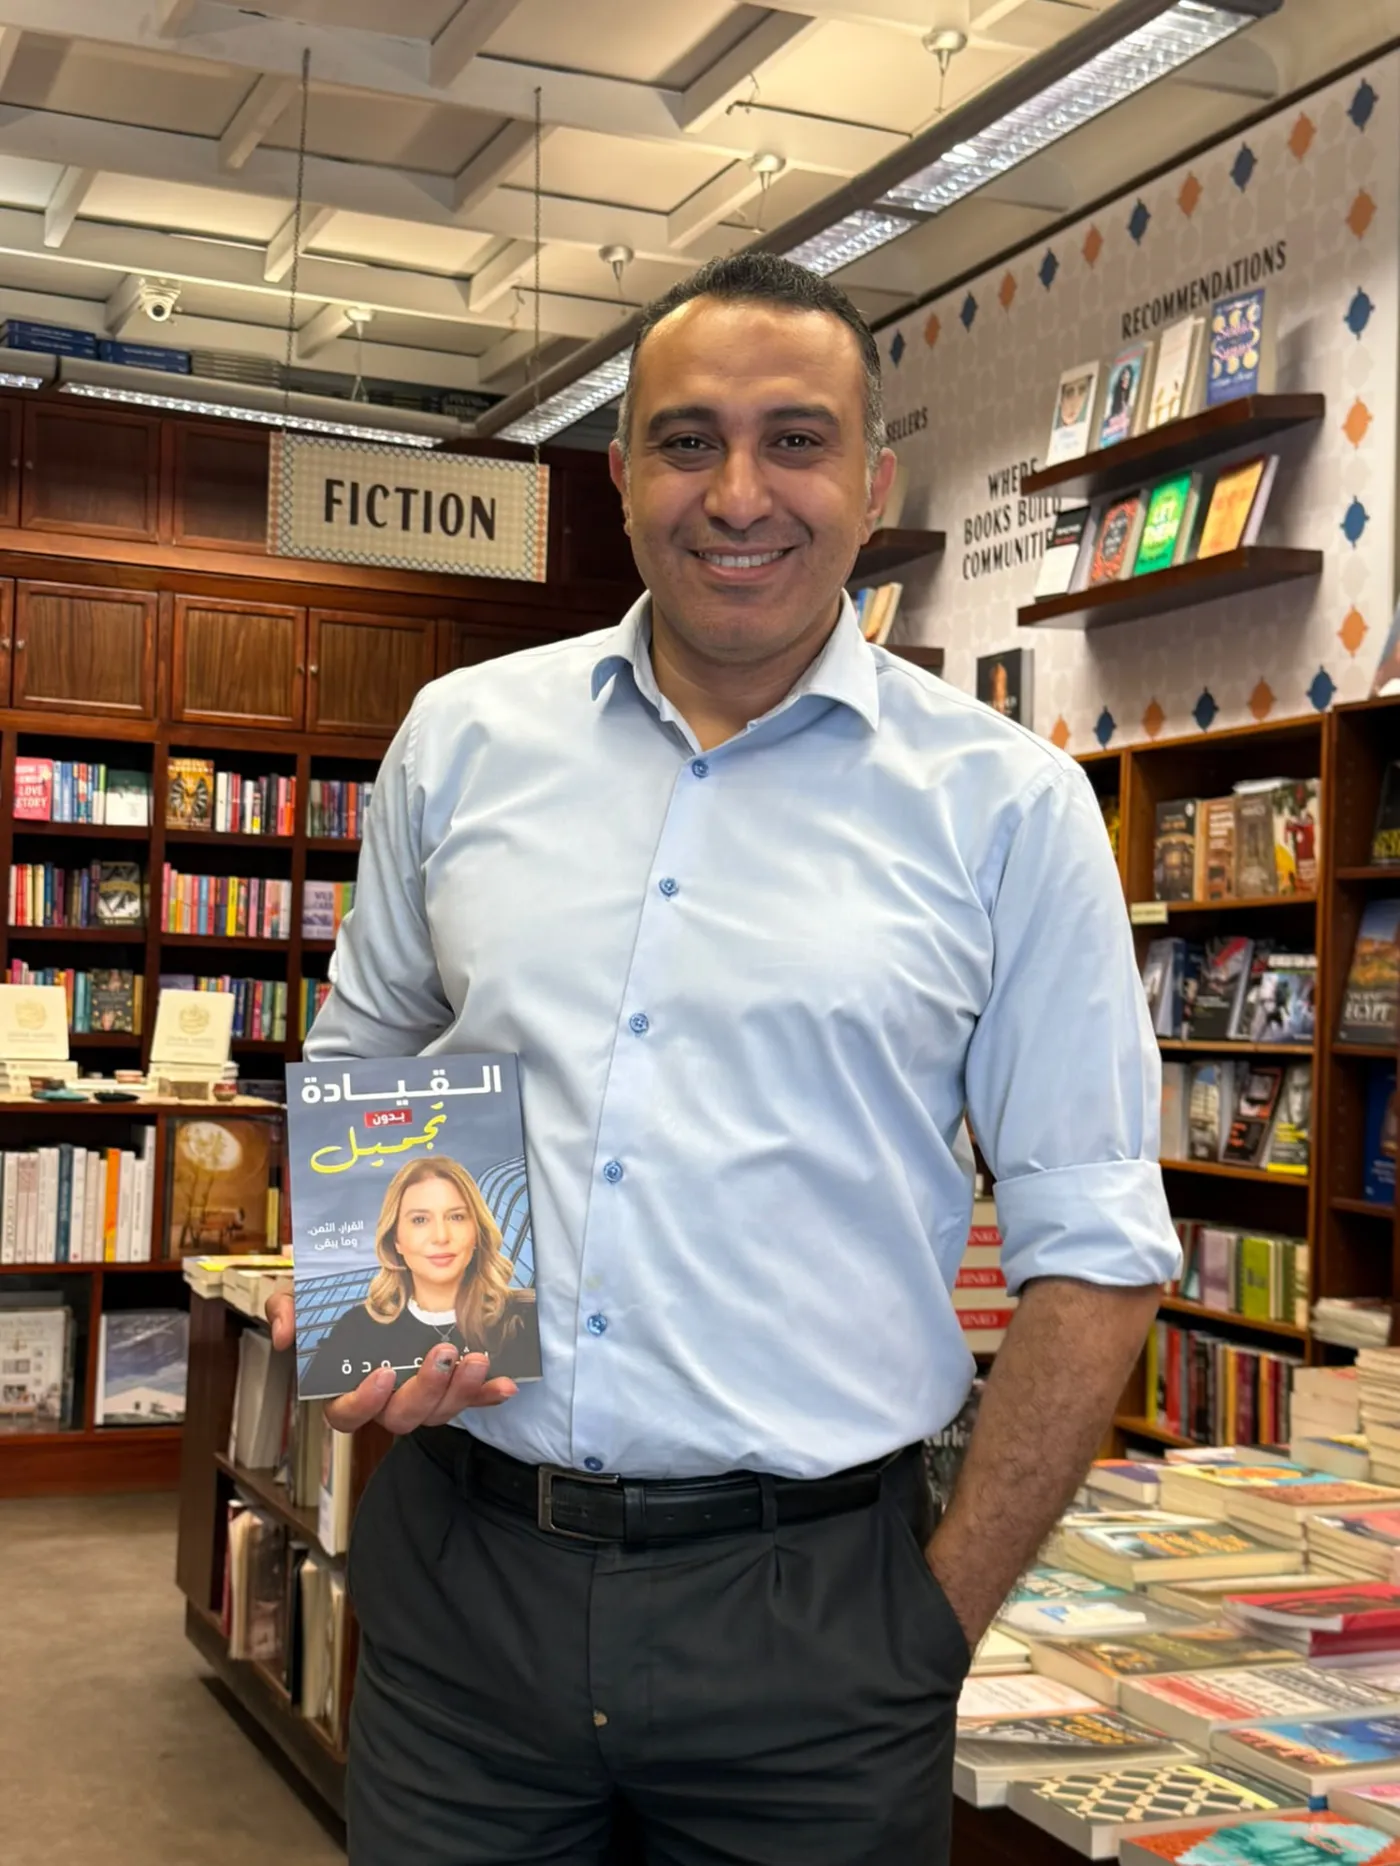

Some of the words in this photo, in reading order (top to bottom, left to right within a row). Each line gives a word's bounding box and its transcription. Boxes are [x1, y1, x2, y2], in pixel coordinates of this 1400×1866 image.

[1121, 240, 1287, 341] RECOMMENDATIONS
[324, 478, 496, 541] FICTION
[964, 504, 1011, 546] BOOKS
[301, 1064, 502, 1106] القيادة
[310, 1101, 447, 1174] تجميل
[372, 1112, 406, 1126] بدون
[314, 1238, 338, 1251] يبقى
[340, 1236, 358, 1248] وما
